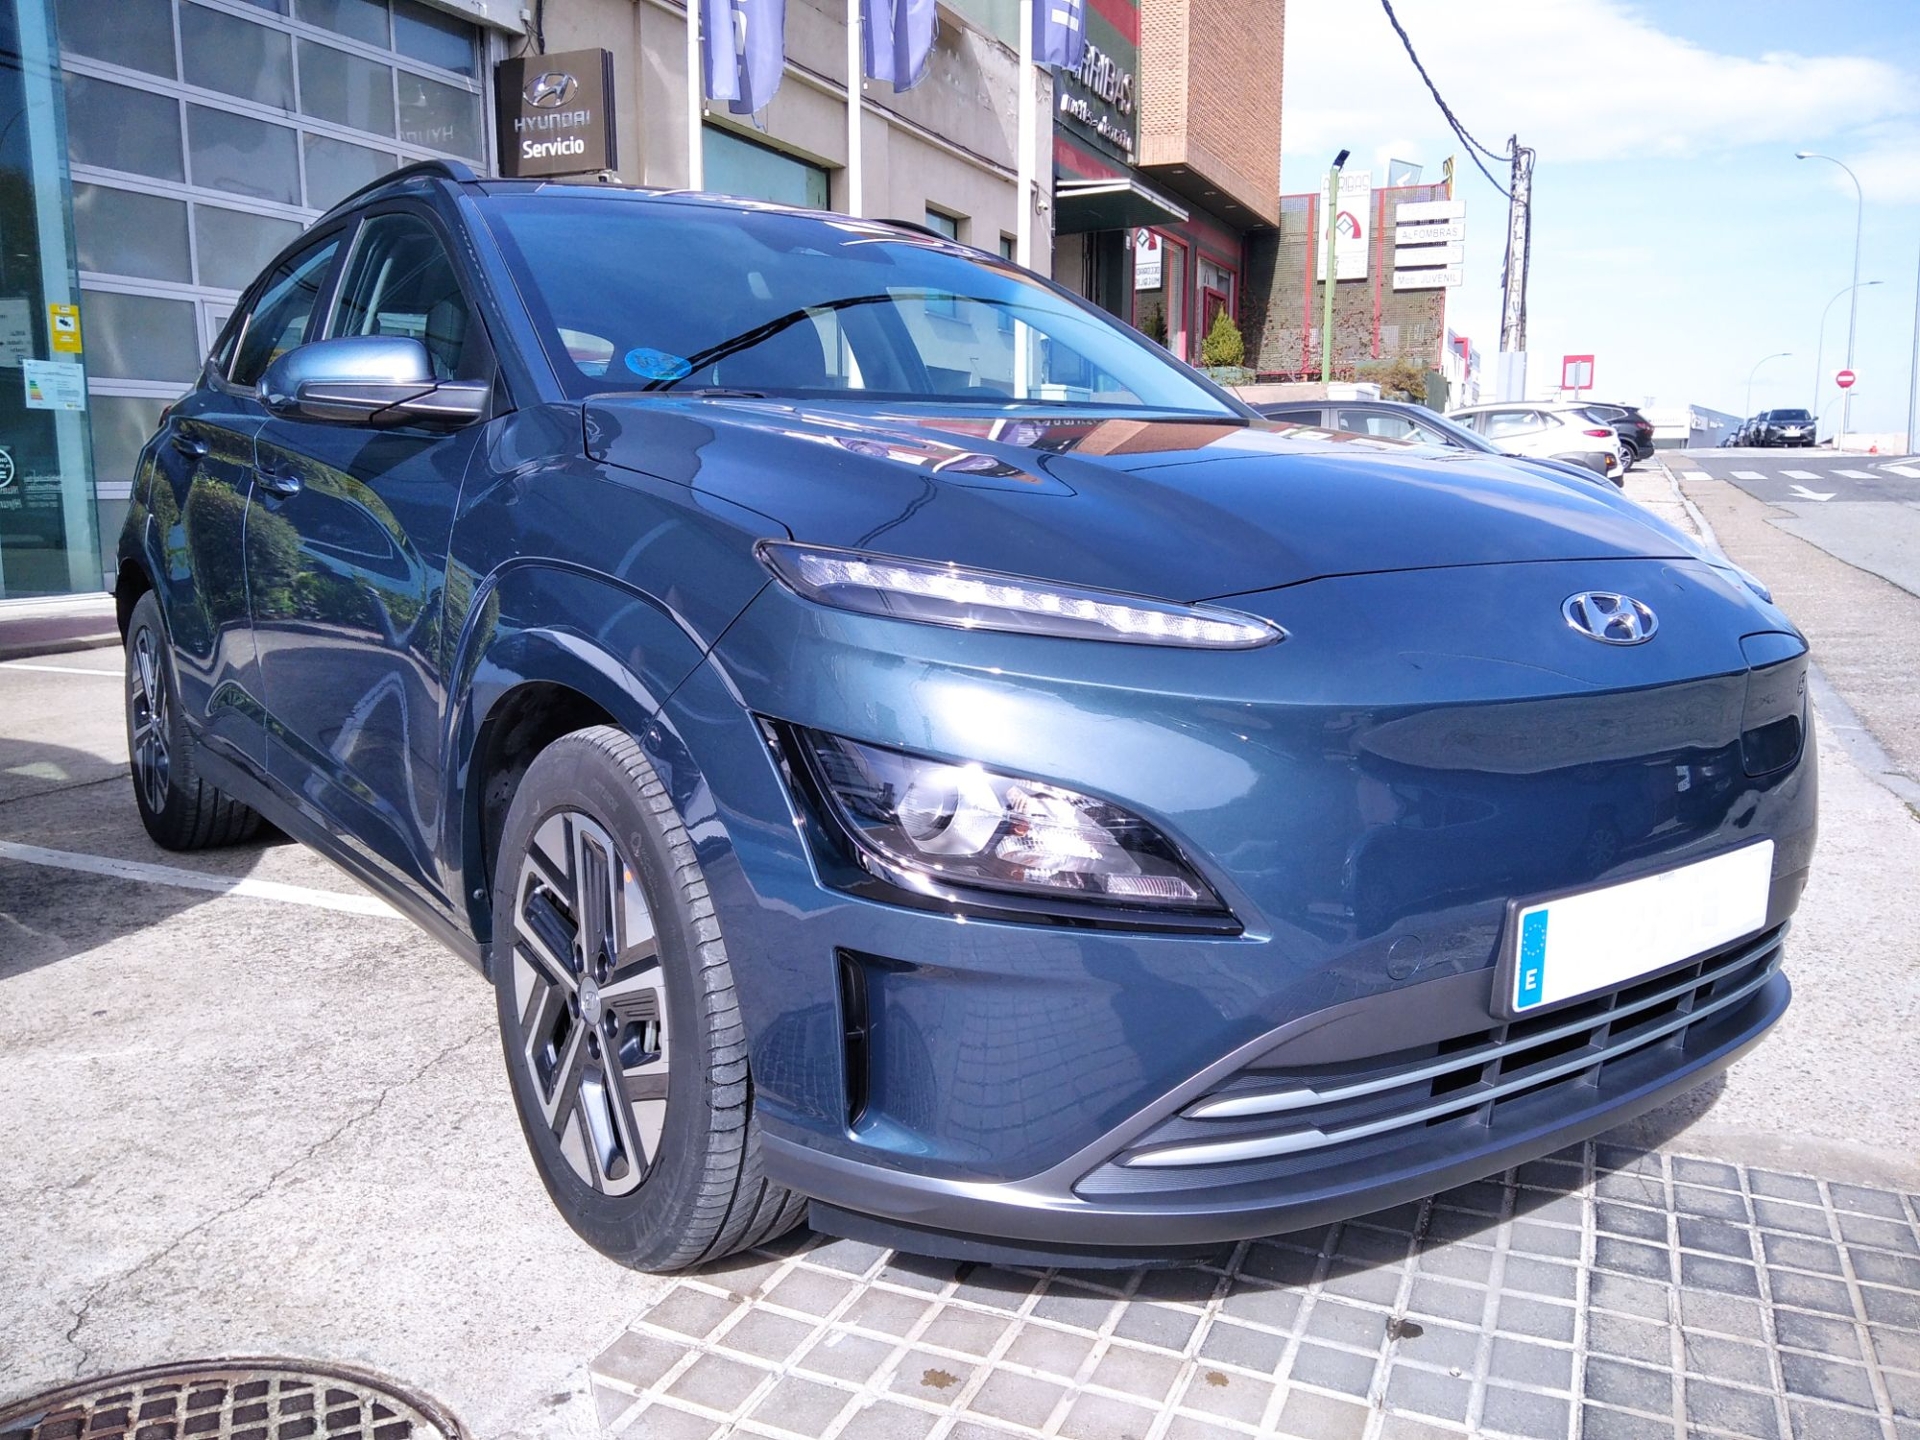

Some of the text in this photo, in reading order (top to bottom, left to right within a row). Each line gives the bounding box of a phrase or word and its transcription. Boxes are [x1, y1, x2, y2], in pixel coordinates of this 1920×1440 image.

[1074, 38, 1135, 116] RRIBAS
[514, 110, 591, 133] HYUNDAI
[522, 136, 584, 159] Servicio
[1322, 174, 1370, 194] ARIBAS
[1525, 968, 1538, 990] E
